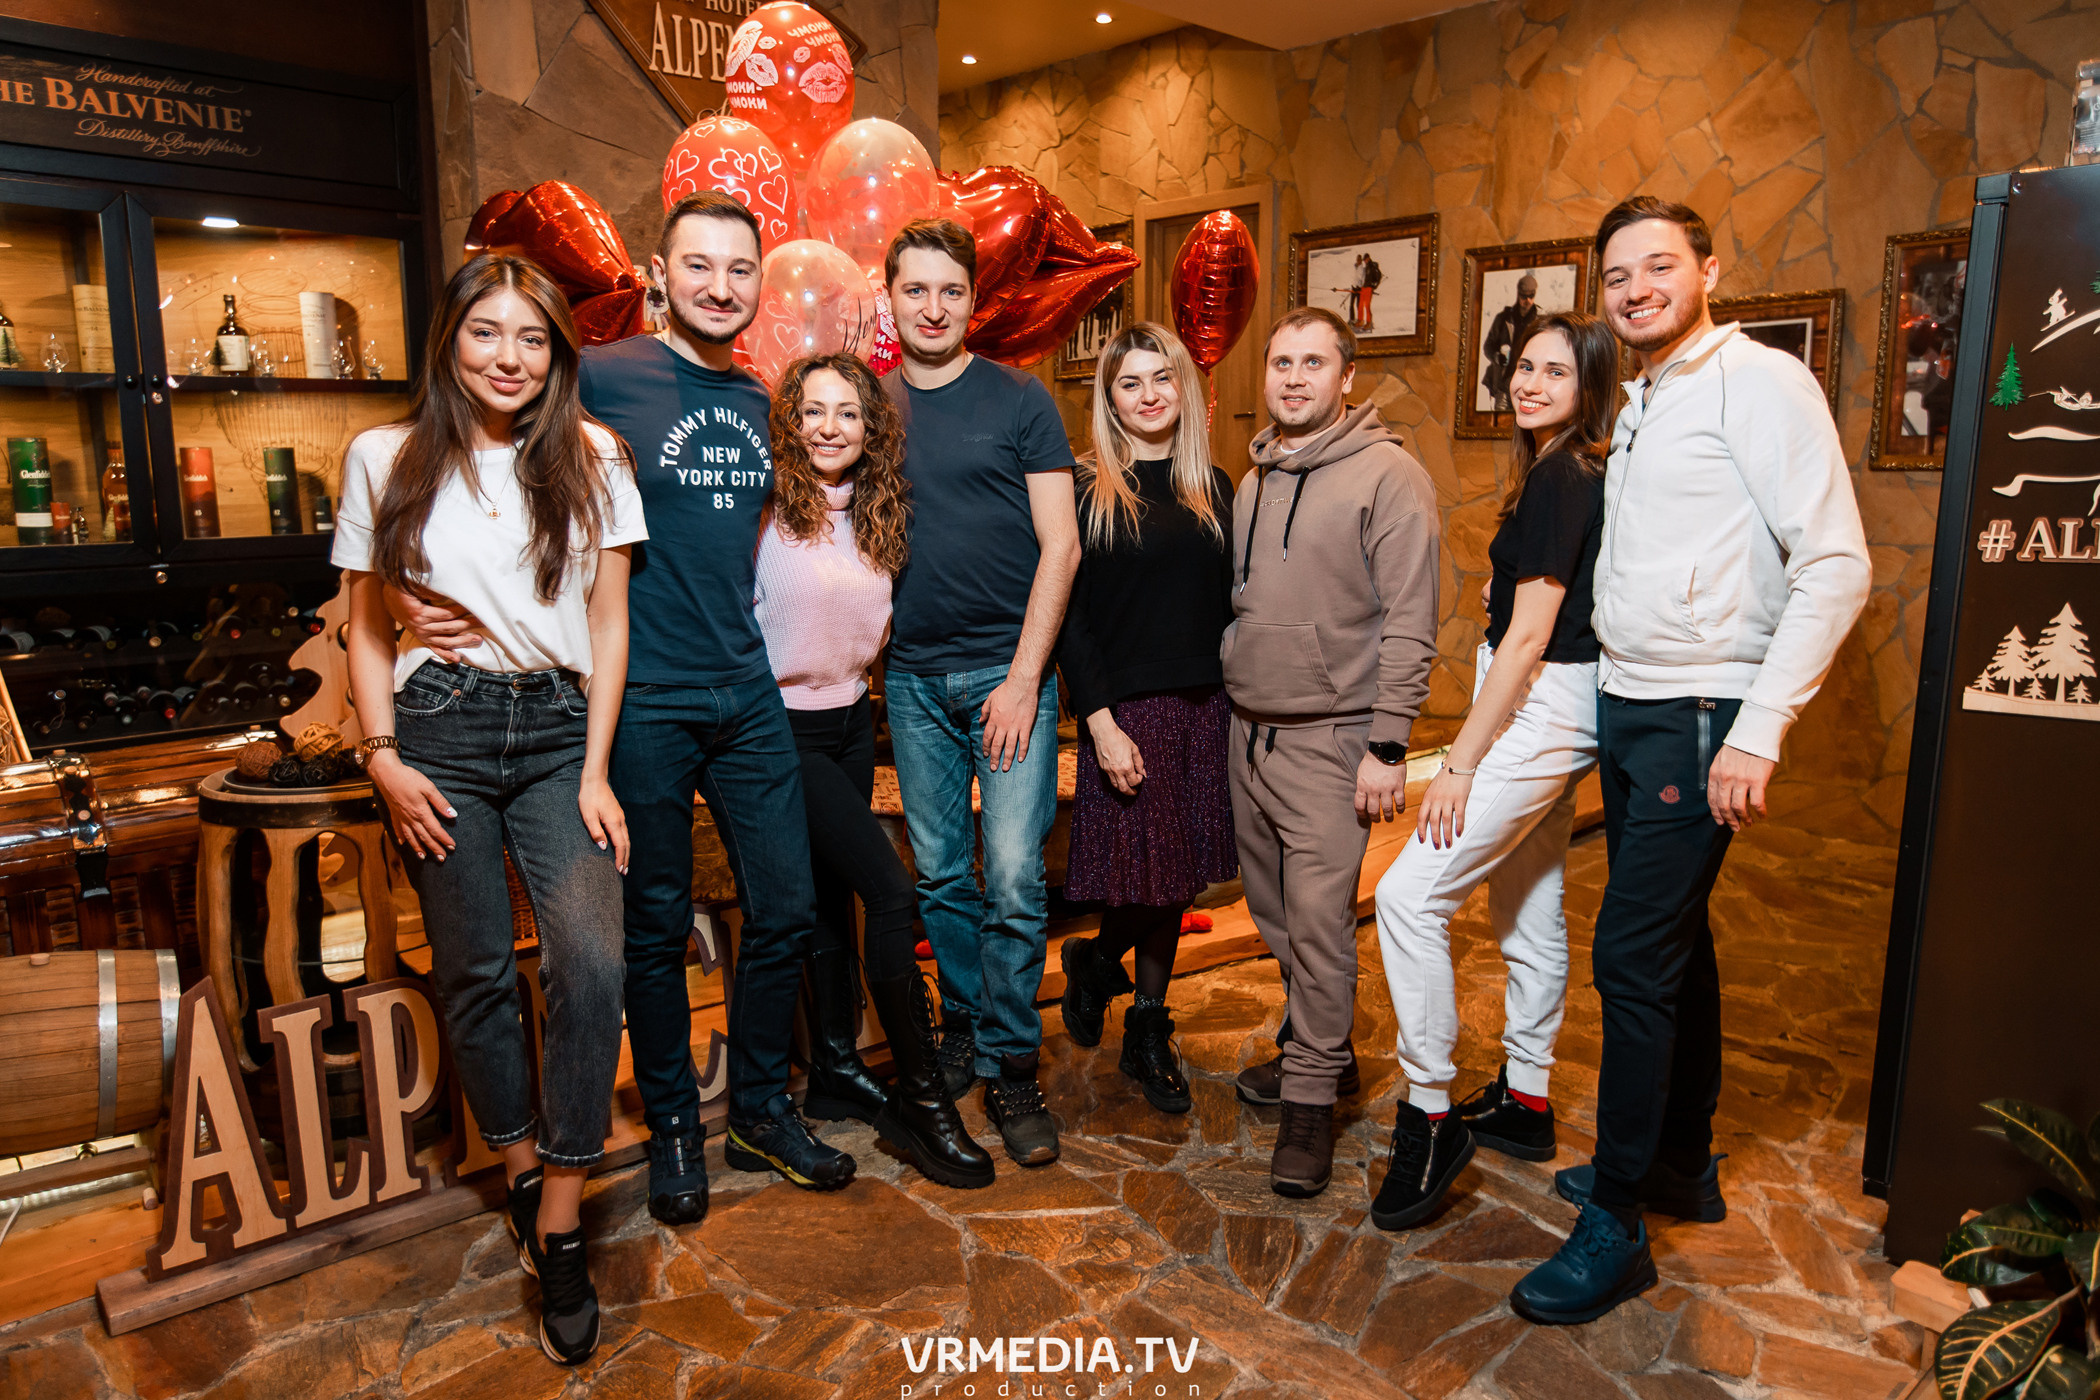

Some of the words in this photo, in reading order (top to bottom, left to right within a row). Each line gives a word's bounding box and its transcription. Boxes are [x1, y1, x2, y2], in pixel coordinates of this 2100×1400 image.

[705, 0, 762, 17] HOTE
[649, 2, 735, 82] ALPE
[75, 61, 192, 95] Handcrafted
[193, 84, 244, 98] at
[725, 81, 763, 94] МОКИ-
[0, 79, 35, 105] HE
[659, 408, 707, 467] TOMMY
[713, 406, 773, 471] HILFIGER
[702, 446, 741, 464] NEW
[675, 468, 724, 487] YORK
[731, 470, 766, 487] CITY
[713, 493, 735, 510] 85
[1979, 518, 2100, 562] #AL
